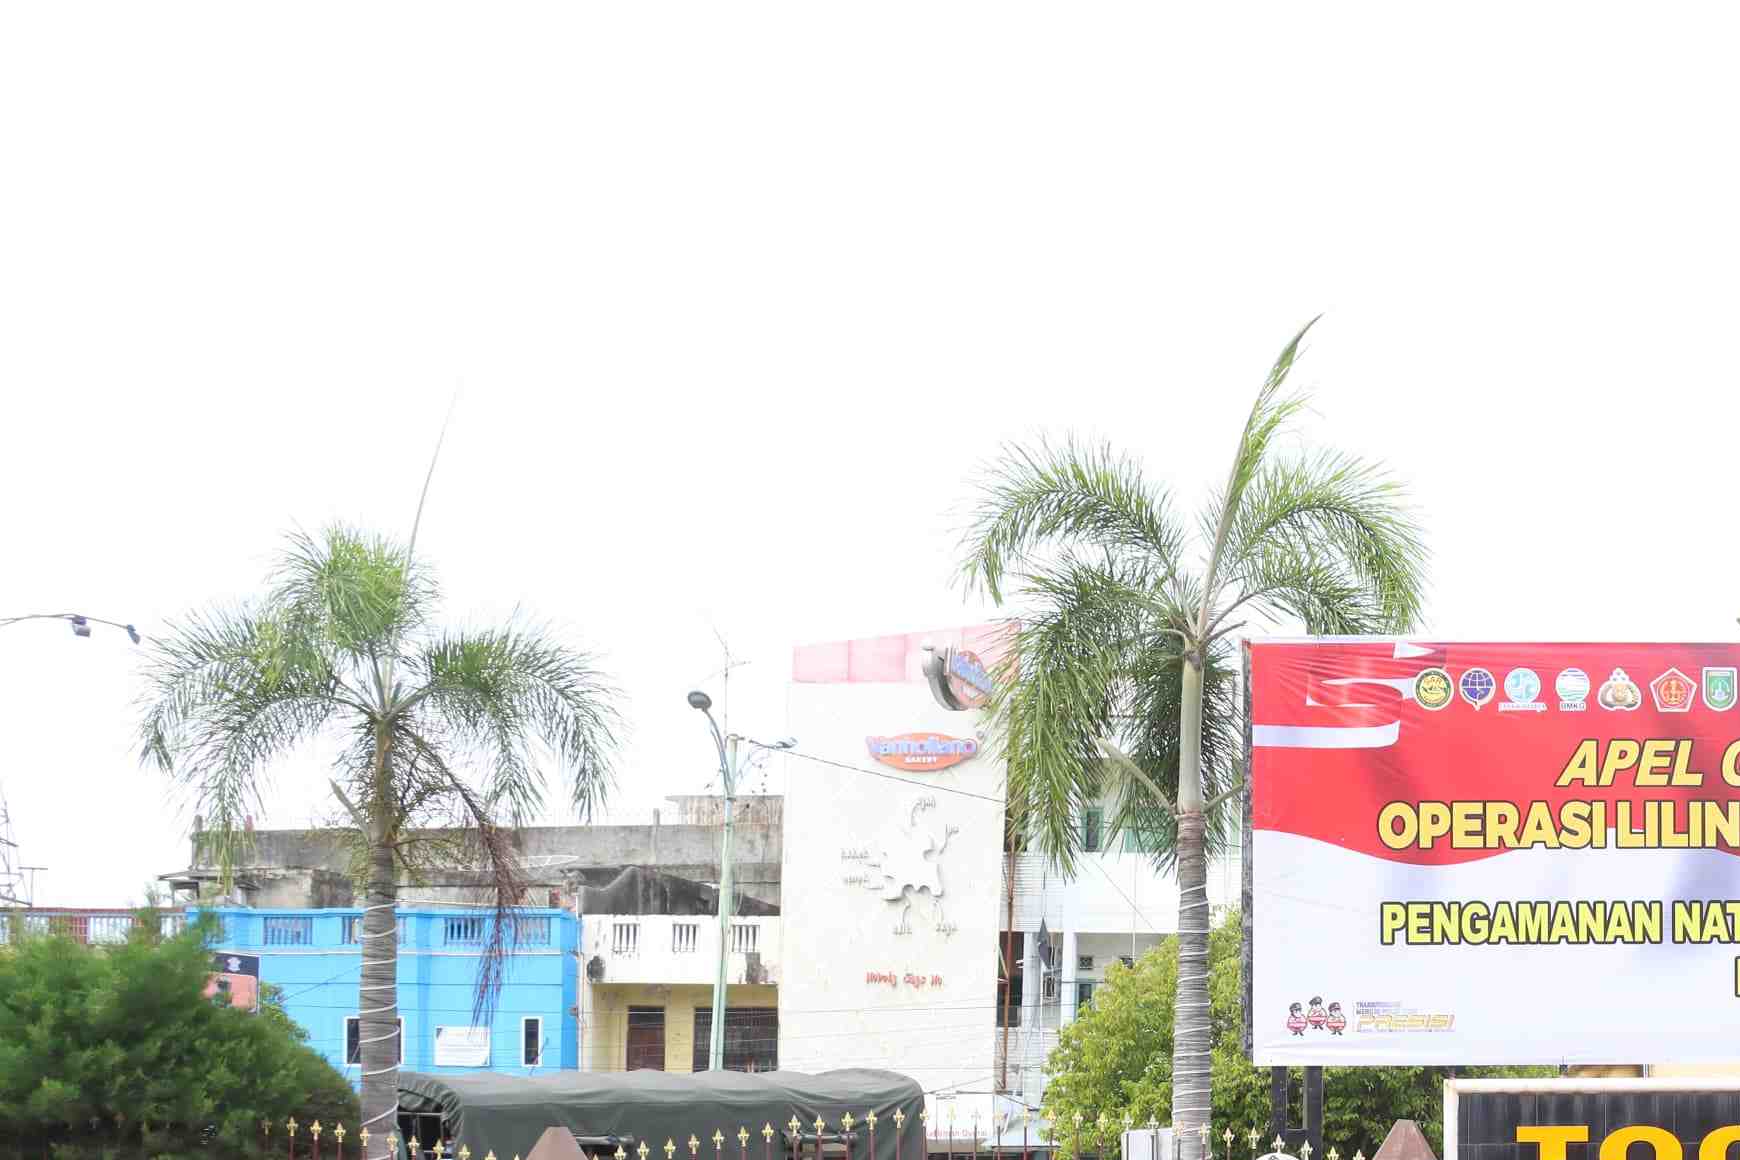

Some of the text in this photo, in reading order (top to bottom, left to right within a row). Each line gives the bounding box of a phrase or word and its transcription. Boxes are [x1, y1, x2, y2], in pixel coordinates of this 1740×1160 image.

[1556, 738, 1704, 788] APEL
[1377, 800, 1607, 850] OPERASI
[1616, 800, 1740, 850] LILIN
[1380, 901, 1661, 945] PENGAMANAN
